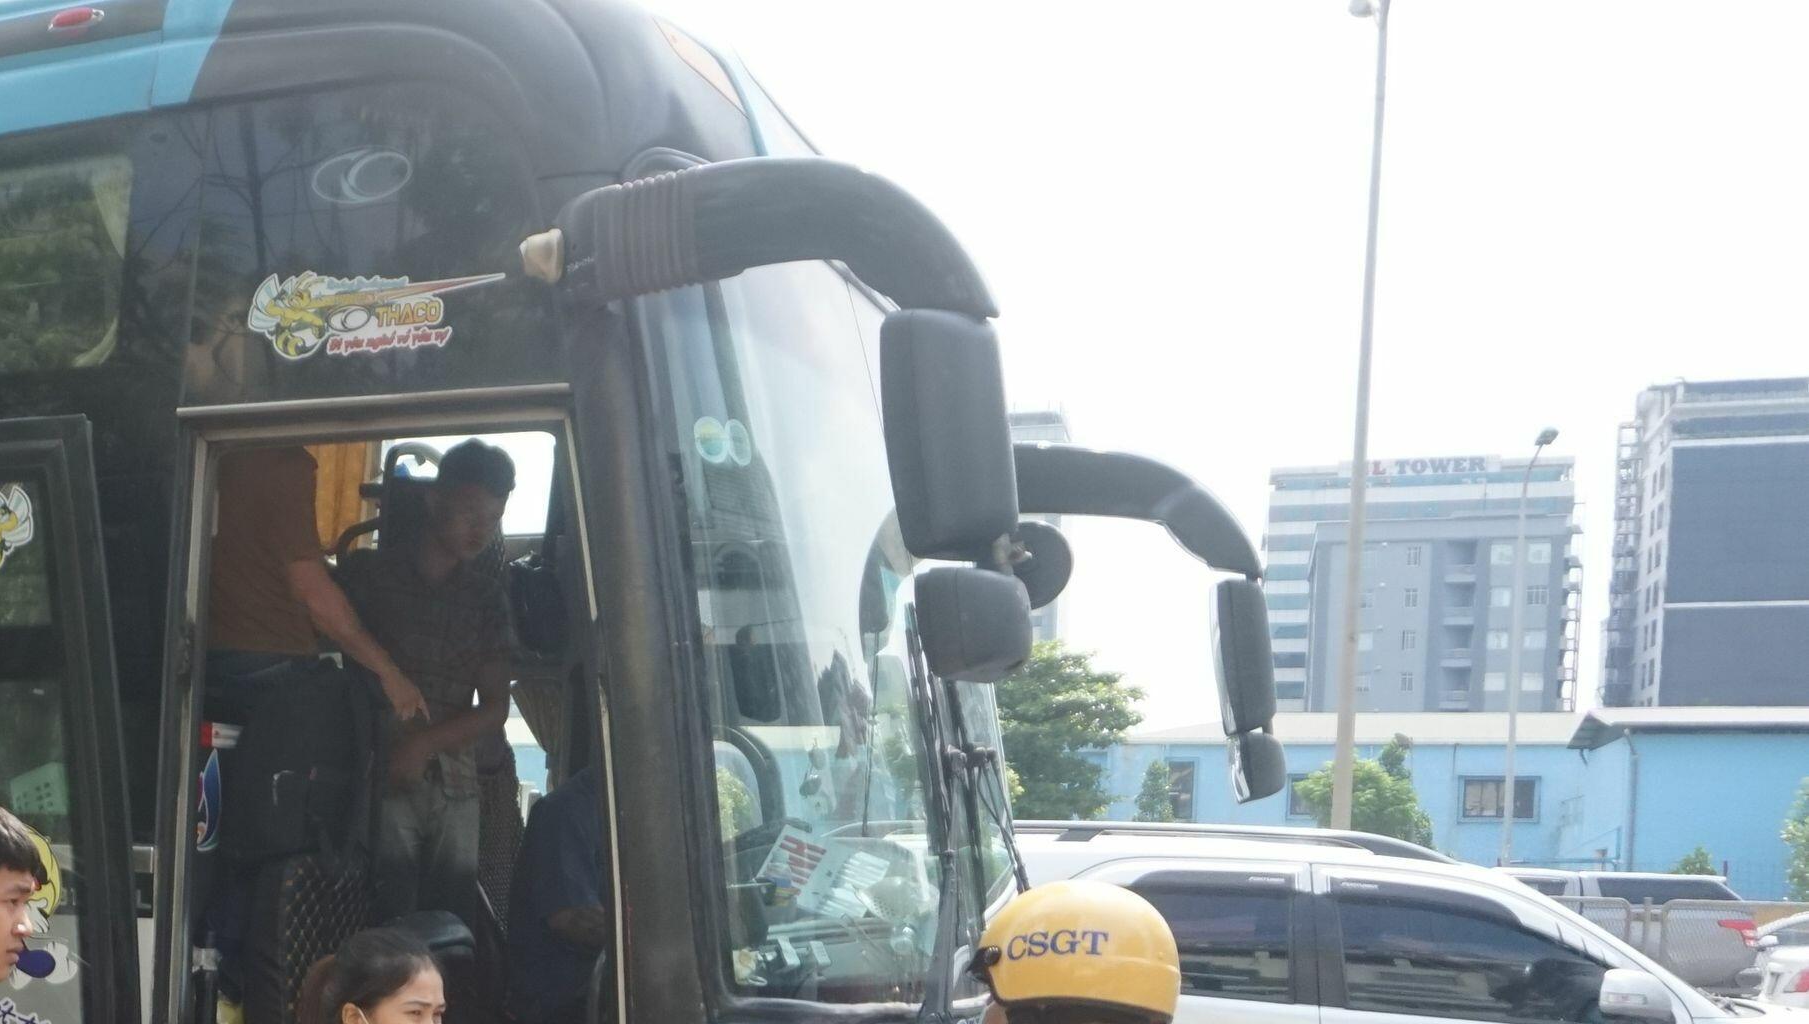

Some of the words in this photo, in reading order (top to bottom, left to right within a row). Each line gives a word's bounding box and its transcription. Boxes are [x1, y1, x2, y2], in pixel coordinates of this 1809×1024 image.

[375, 301, 442, 328] THACO
[1395, 456, 1486, 475] TOWER
[1007, 929, 1109, 961] CSGT
